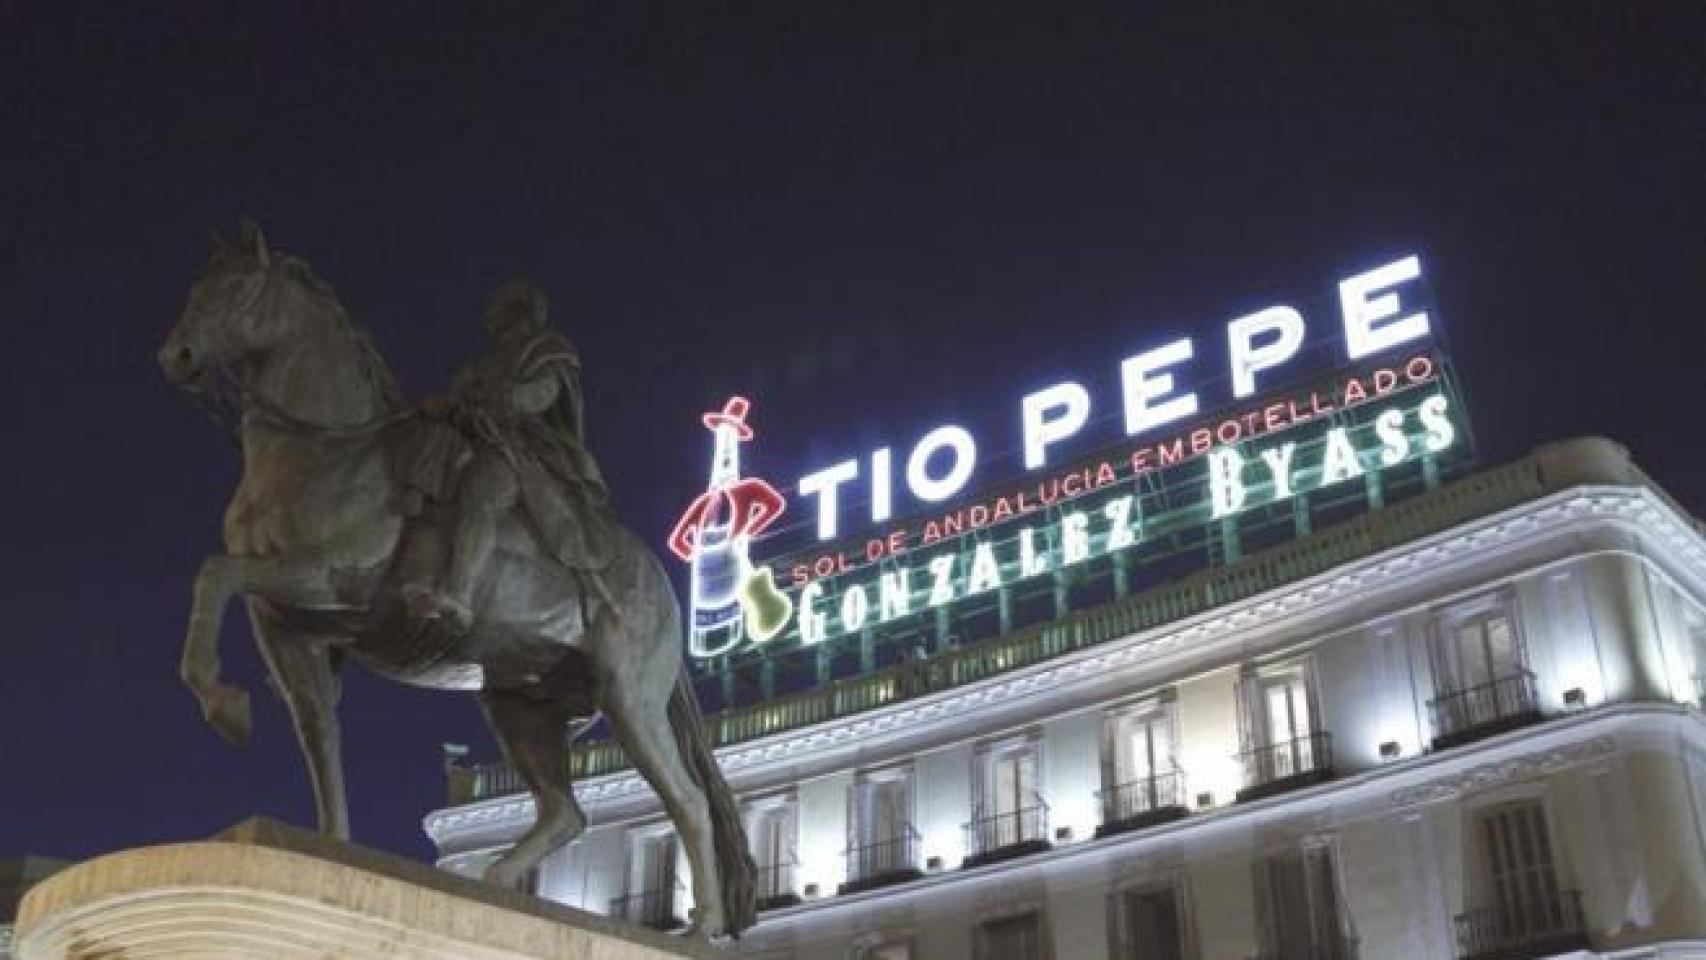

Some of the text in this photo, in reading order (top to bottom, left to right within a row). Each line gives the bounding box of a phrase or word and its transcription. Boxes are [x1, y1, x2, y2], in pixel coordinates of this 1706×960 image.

[791, 356, 1433, 587] SOL DE ANDALUCIA EMBOTELLADO
[798, 253, 1431, 541] TIO PEPE
[1208, 394, 1454, 519] BYASS
